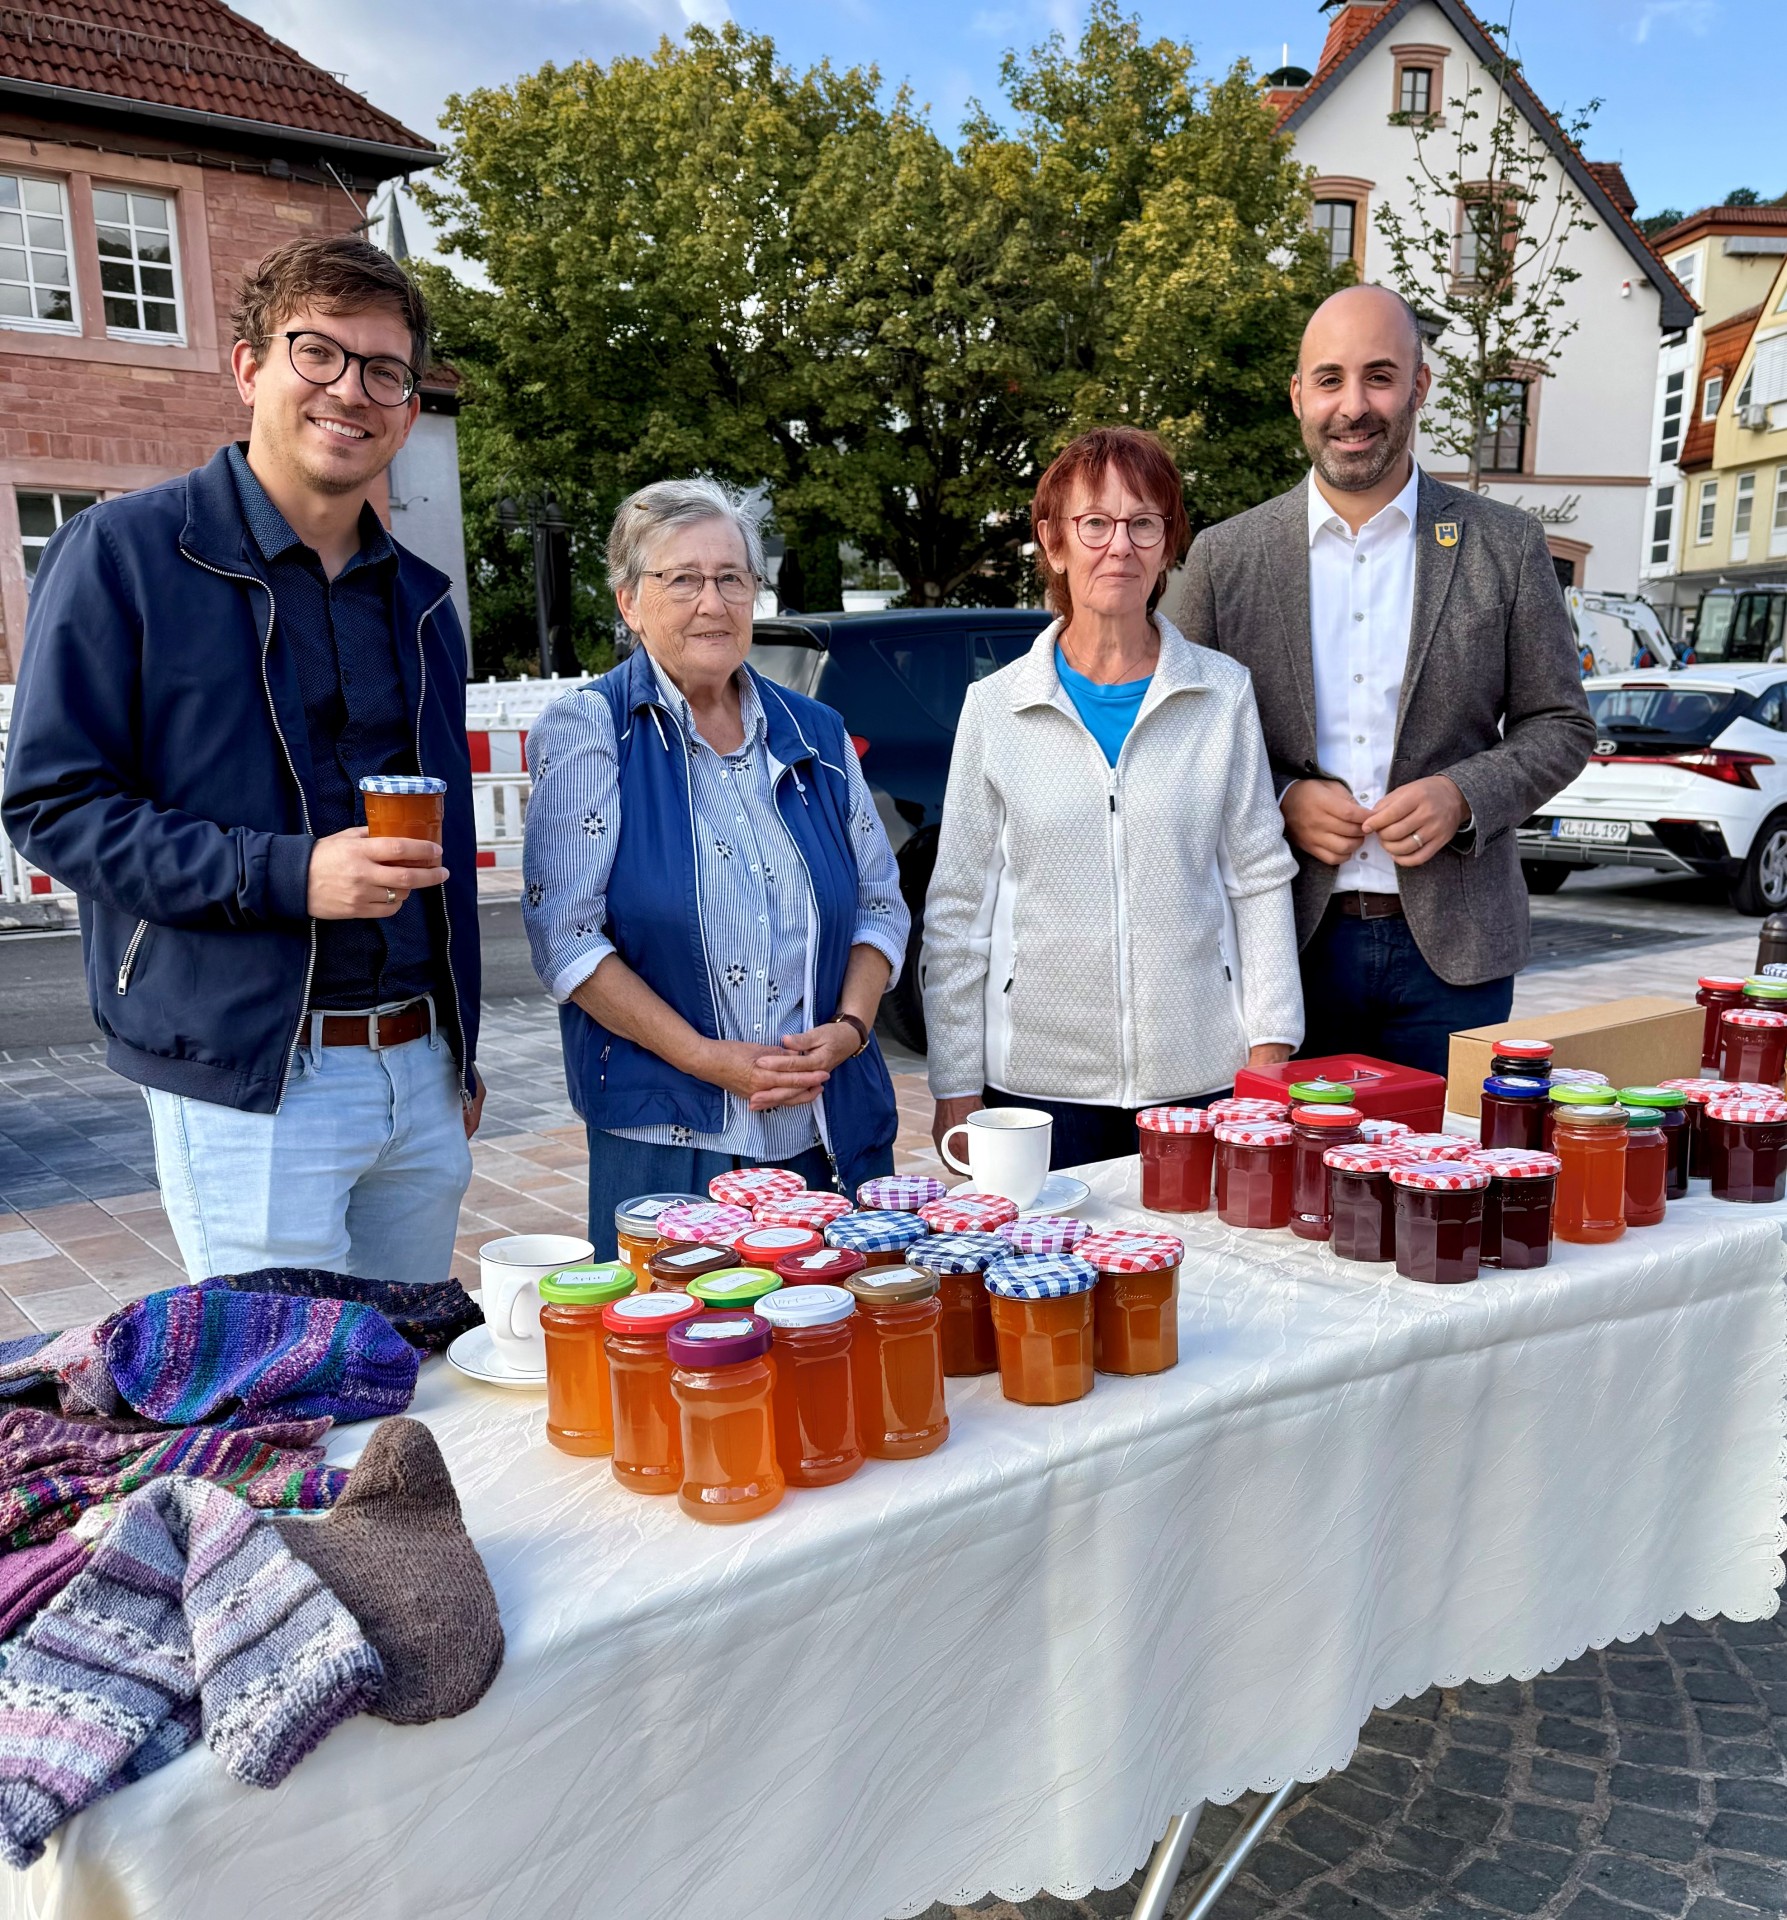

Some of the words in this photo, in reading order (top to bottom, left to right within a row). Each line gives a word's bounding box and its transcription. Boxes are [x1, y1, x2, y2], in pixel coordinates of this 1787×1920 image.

[1560, 820, 1575, 835] KL
[1582, 821, 1599, 837] LL
[1601, 823, 1628, 838] 197
